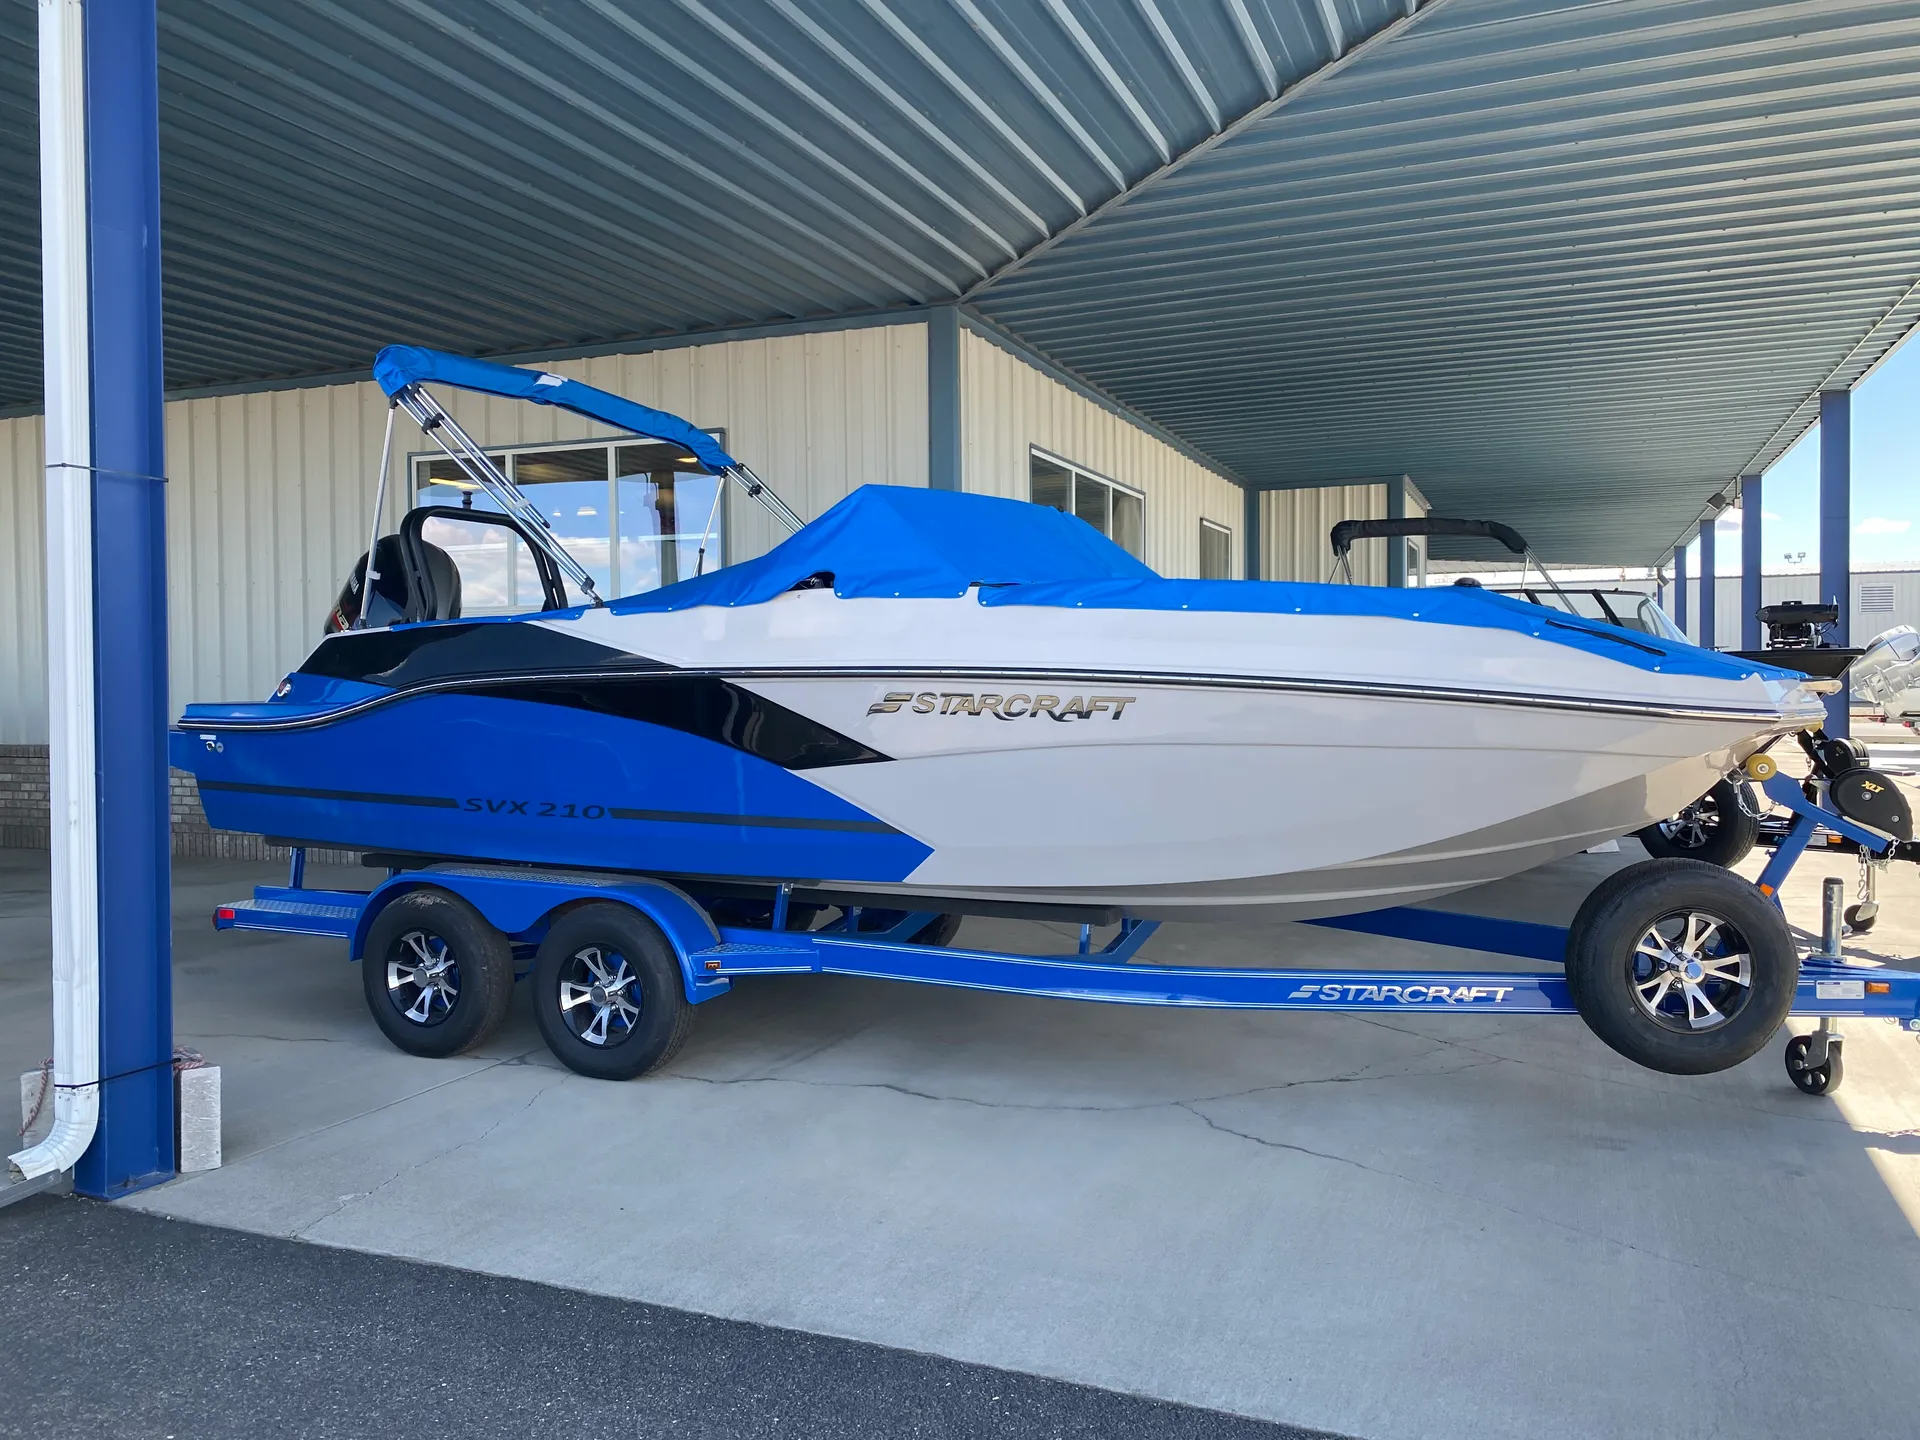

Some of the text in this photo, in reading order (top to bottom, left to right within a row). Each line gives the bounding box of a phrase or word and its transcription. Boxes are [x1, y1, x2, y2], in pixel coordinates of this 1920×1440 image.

[911, 691, 1137, 723] STARCRAFT
[1861, 780, 1884, 793] XLT
[463, 798, 605, 820] SVX 210
[1318, 984, 1514, 1005] STARCRAFT
